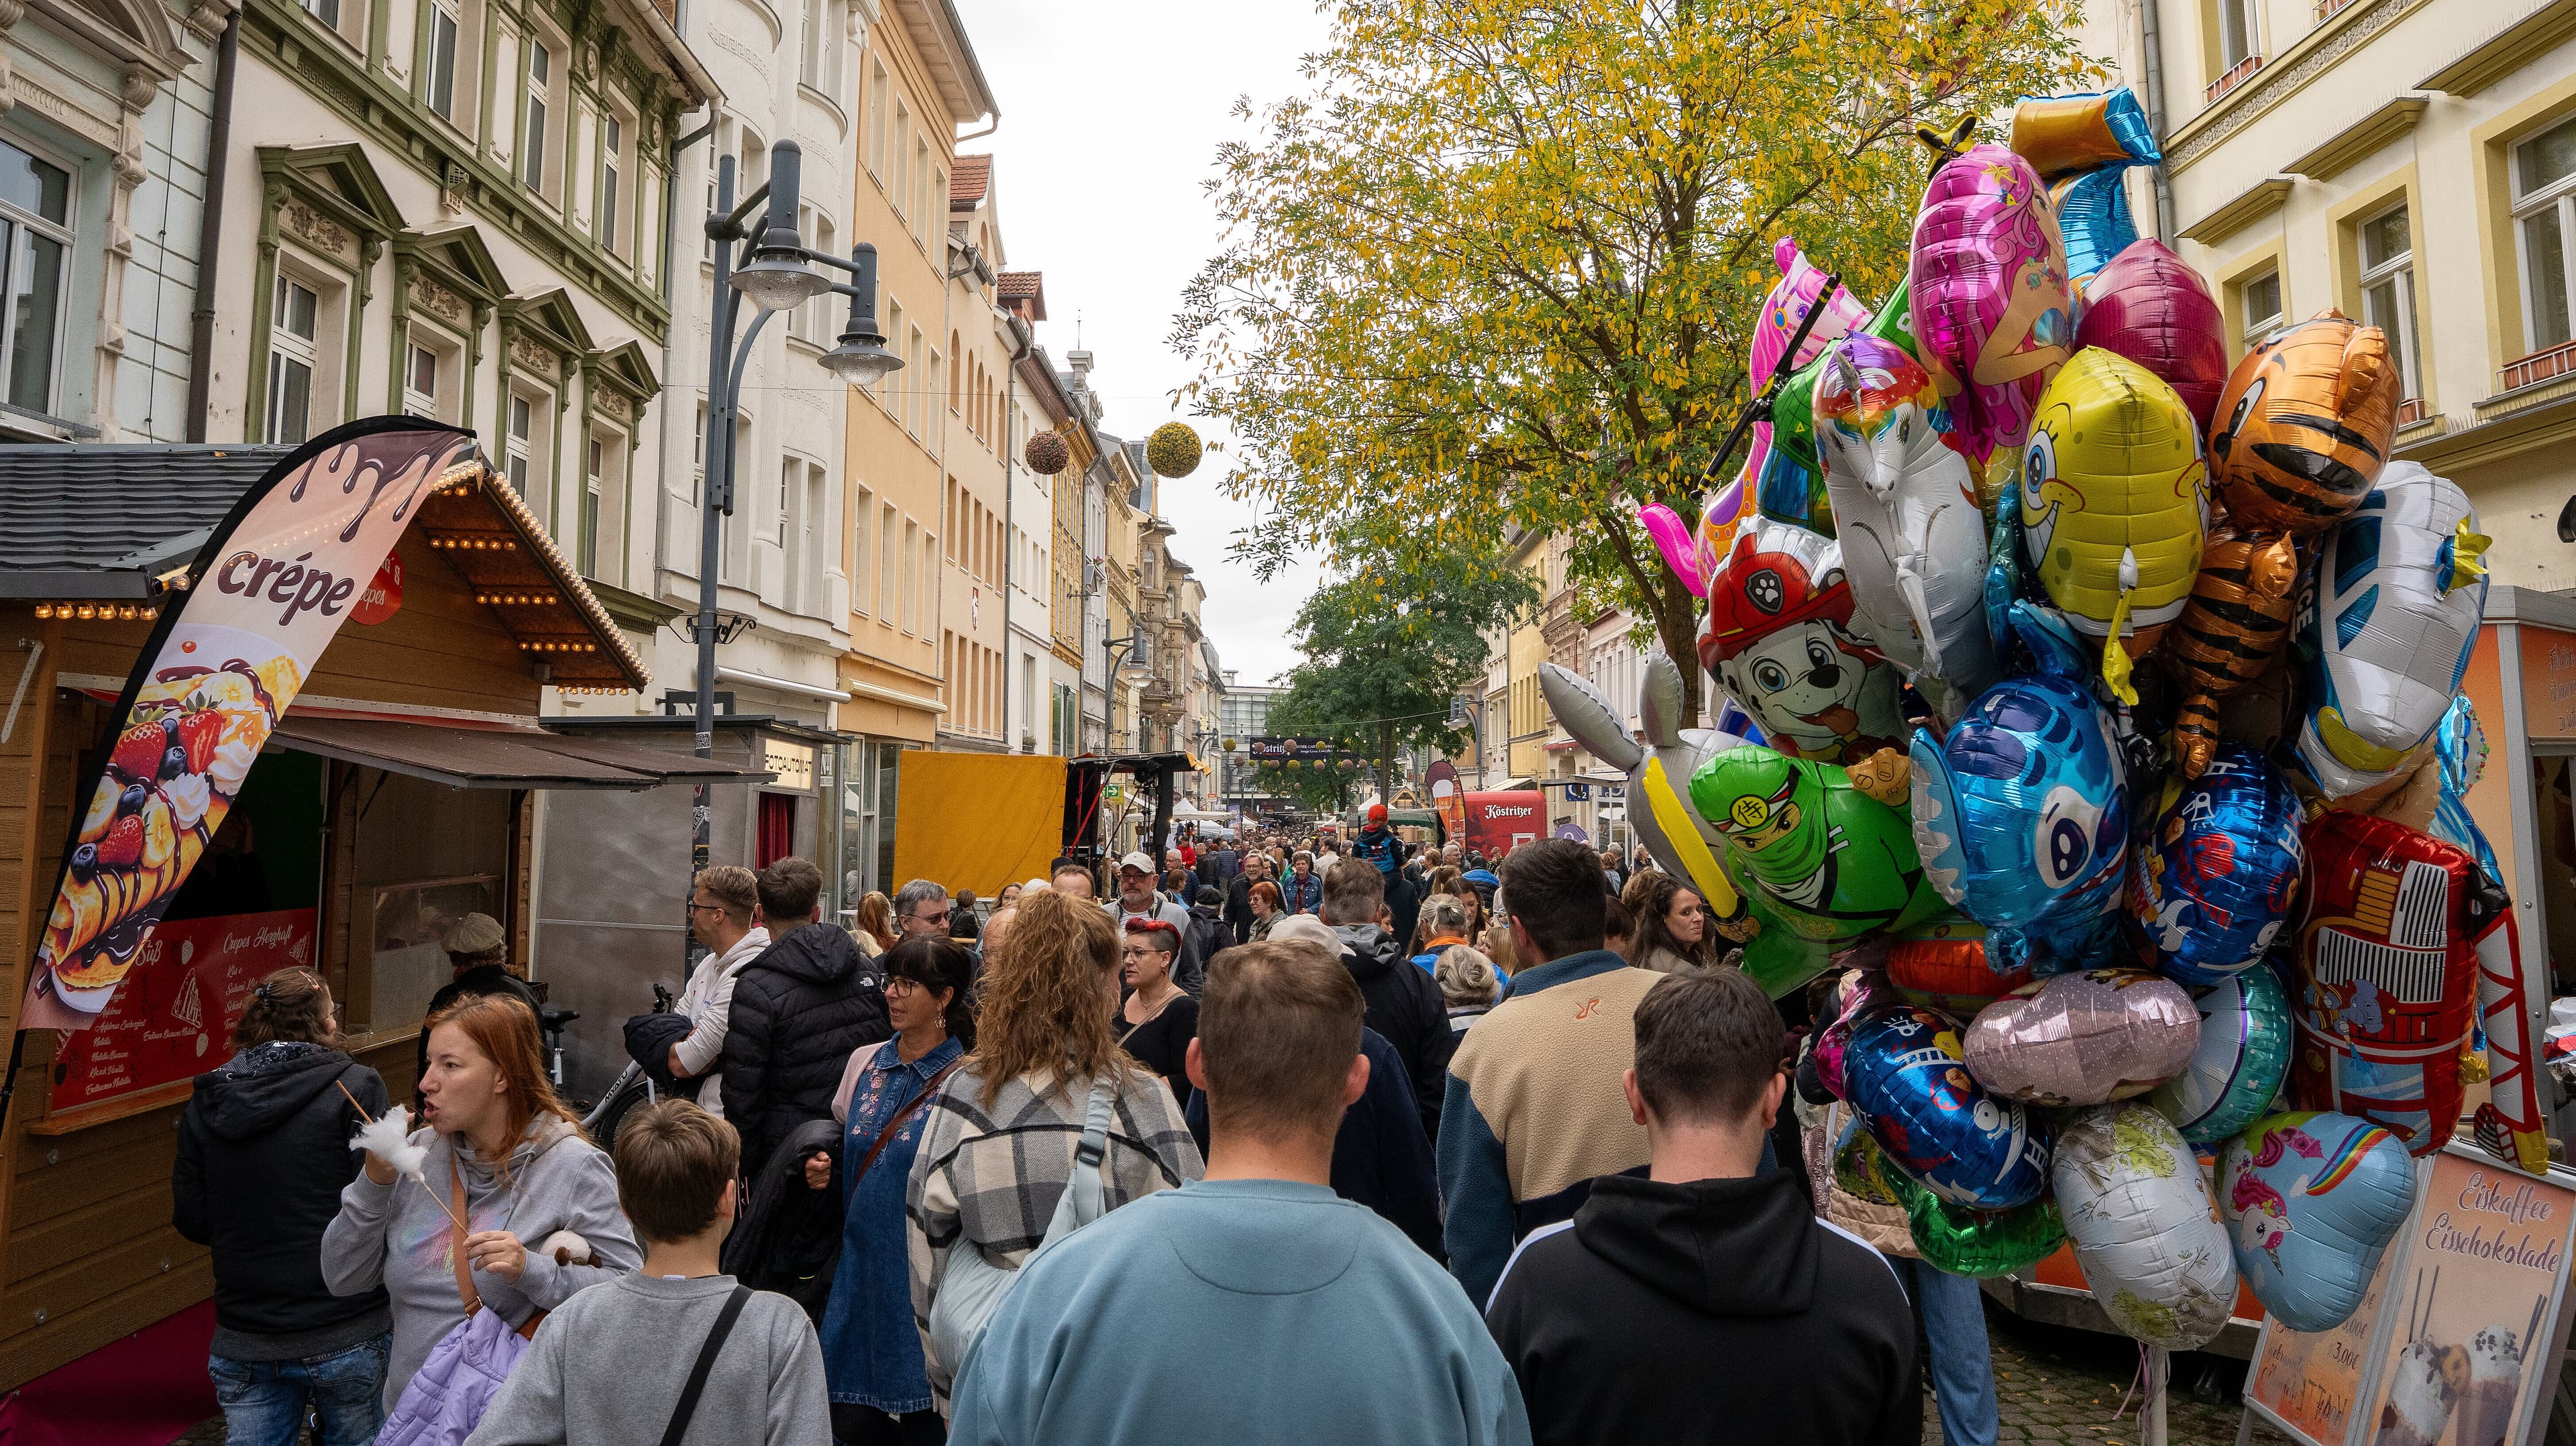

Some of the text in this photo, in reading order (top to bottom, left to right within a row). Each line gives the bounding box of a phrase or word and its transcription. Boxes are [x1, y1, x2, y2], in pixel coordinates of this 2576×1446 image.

[217, 551, 355, 626] crépe
[359, 588, 386, 611] epes
[765, 754, 812, 775] FOTOAUTOMAT
[1485, 805, 1532, 819] Köstritzer
[1737, 800, 1764, 824] 侍
[223, 924, 294, 954] Crepes Herzhaft
[135, 940, 162, 966] Süß
[2458, 1170, 2551, 1225] Eiskaffee
[2425, 1211, 2560, 1272] Eisschokolade
[2332, 1341, 2360, 1370] 3,00€
